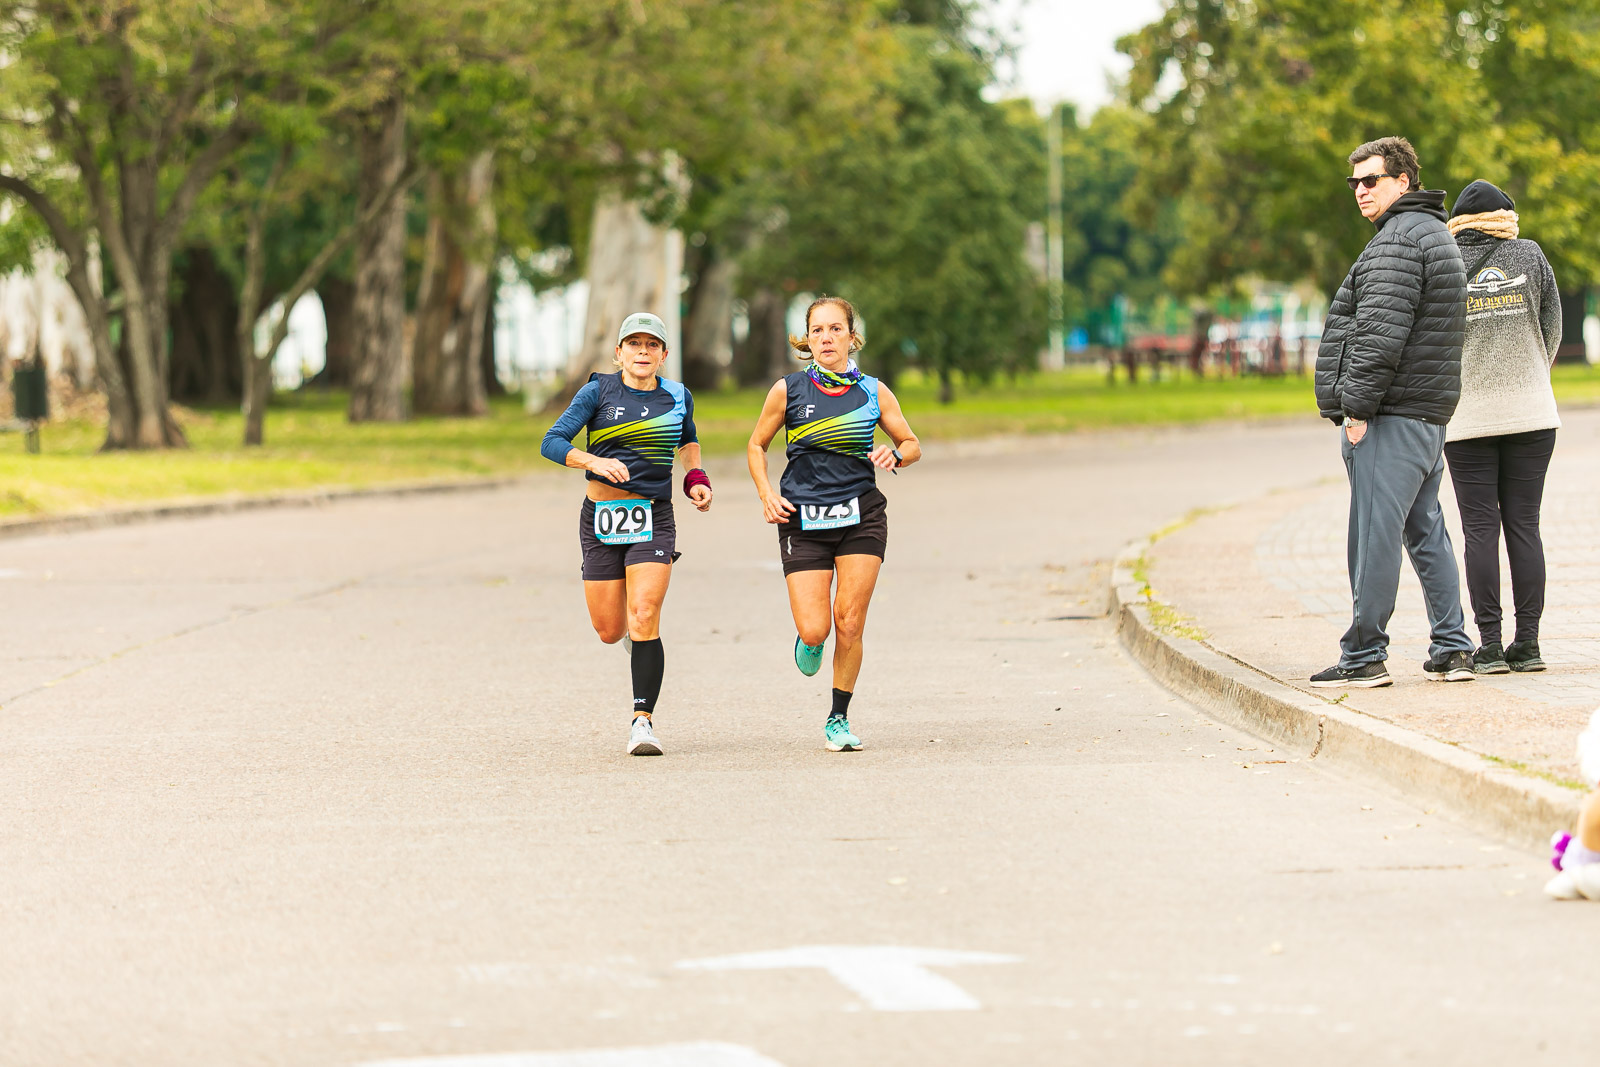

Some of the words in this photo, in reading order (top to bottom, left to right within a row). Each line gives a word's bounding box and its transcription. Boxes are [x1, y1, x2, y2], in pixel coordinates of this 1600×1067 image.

[1466, 290, 1523, 310] Patagonia
[605, 406, 626, 420] SF
[797, 404, 816, 419] SF
[598, 506, 647, 536] 029
[805, 521, 835, 529] DIAMANTE
[836, 518, 857, 527] CORRE
